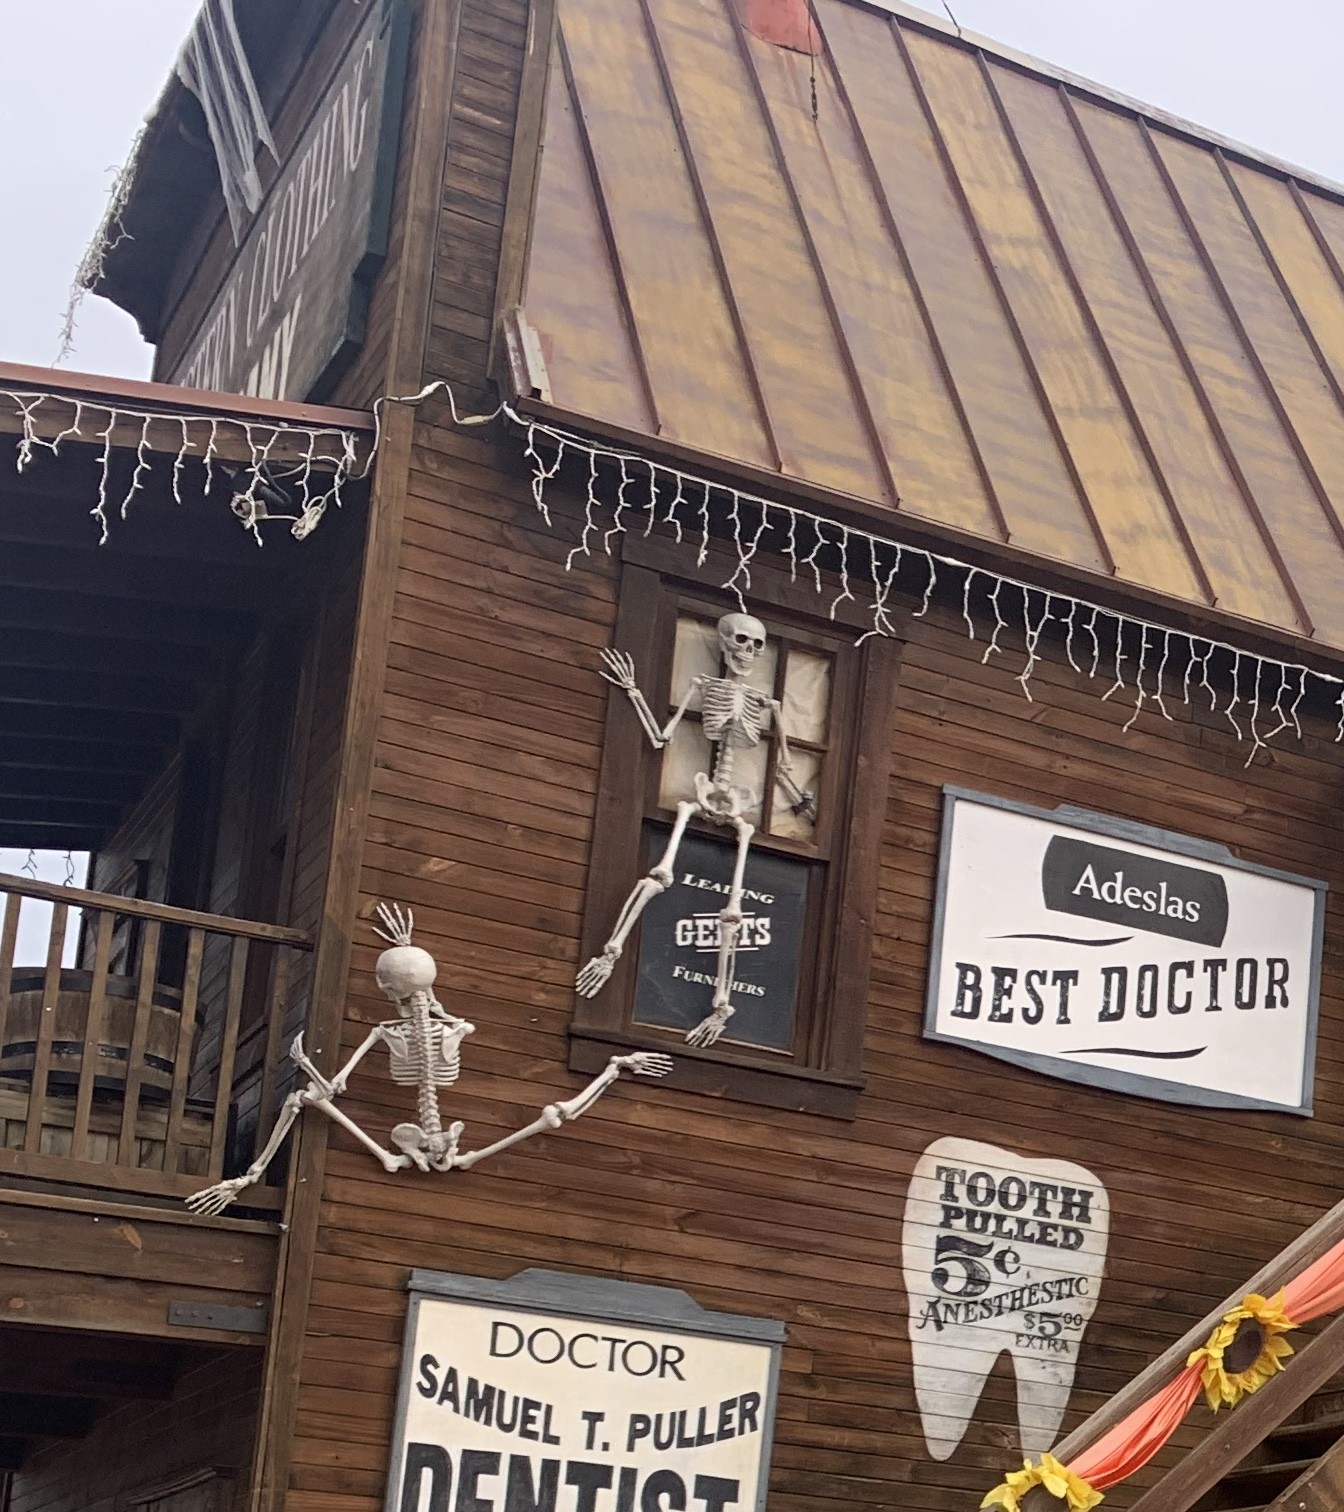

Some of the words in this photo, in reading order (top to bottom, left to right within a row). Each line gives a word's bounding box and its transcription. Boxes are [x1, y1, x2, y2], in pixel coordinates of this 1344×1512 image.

[246, 38, 374, 347] CLOTHING
[1072, 863, 1201, 923] Adeslas
[675, 917, 771, 947] GETS
[950, 961, 1079, 1026] BEST
[1097, 957, 1290, 1023] DOCTOR
[935, 1165, 1095, 1224] TOOTH
[939, 1204, 1085, 1251] PULLED
[916, 1276, 1090, 1332] ANESTHESTIC
[489, 1321, 686, 1381] DOCTOR
[1015, 1332, 1072, 1354] EXTRA
[416, 1354, 561, 1446] SAMUEL
[581, 1411, 610, 1452] T.
[626, 1391, 761, 1452] PULLER
